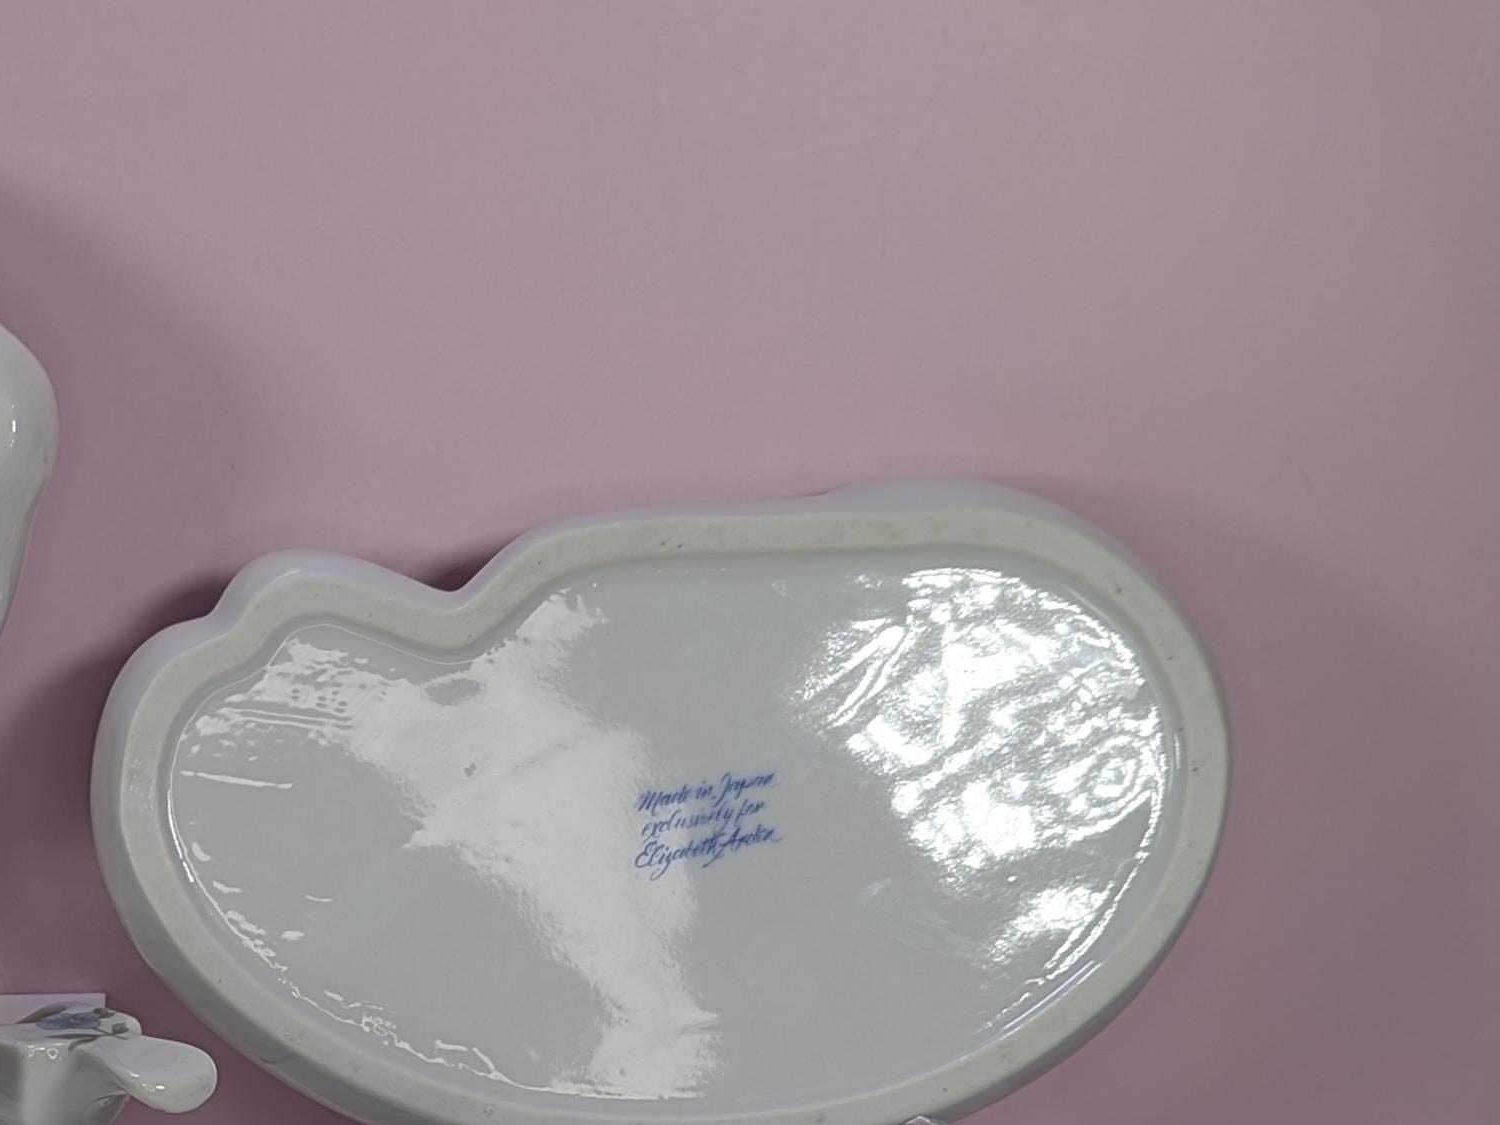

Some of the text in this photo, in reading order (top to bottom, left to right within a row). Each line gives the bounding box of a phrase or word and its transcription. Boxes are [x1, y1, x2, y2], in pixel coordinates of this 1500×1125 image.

[634, 772, 776, 816] Made in Japan
[642, 799, 766, 843] exclusively for
[635, 824, 783, 881] Elizabeth Arden
